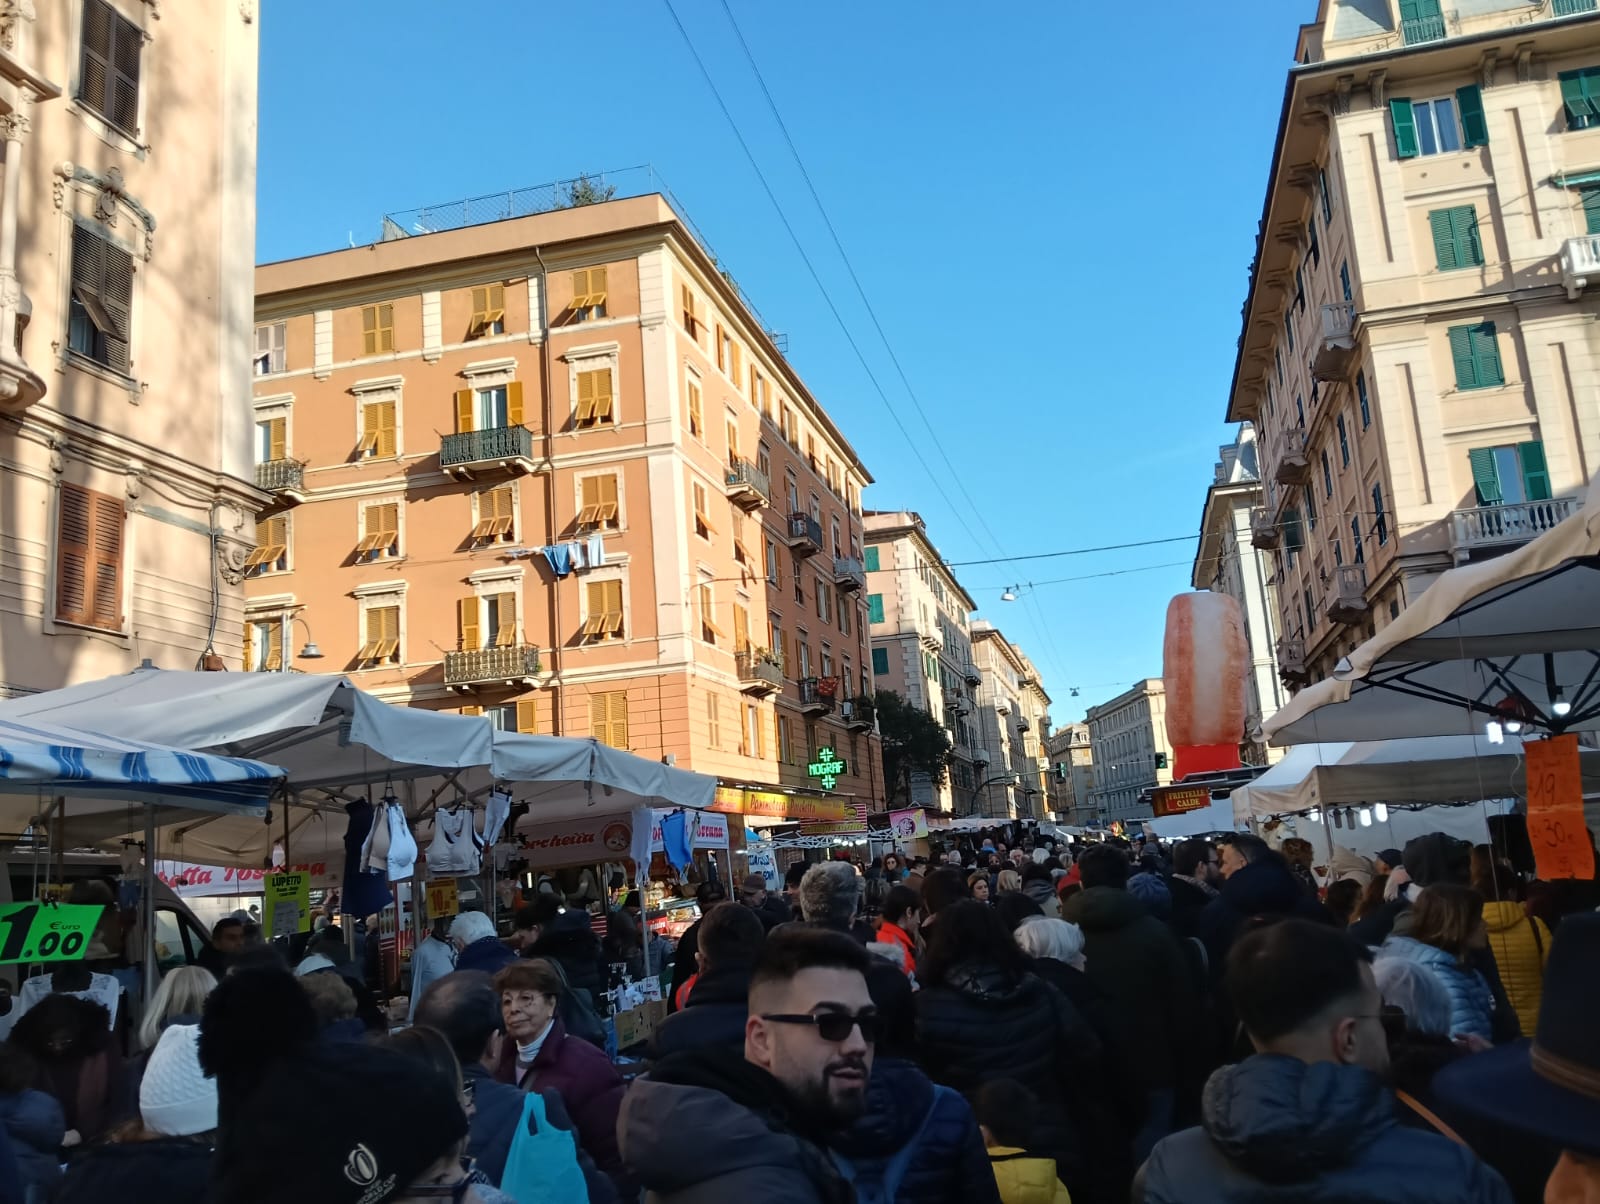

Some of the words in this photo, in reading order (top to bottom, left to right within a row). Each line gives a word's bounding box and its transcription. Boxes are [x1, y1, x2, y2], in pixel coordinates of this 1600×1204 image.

[1169, 789, 1205, 800] FRITTELLE
[1176, 798, 1201, 808] CALDE
[271, 875, 302, 888] LUPETTO
